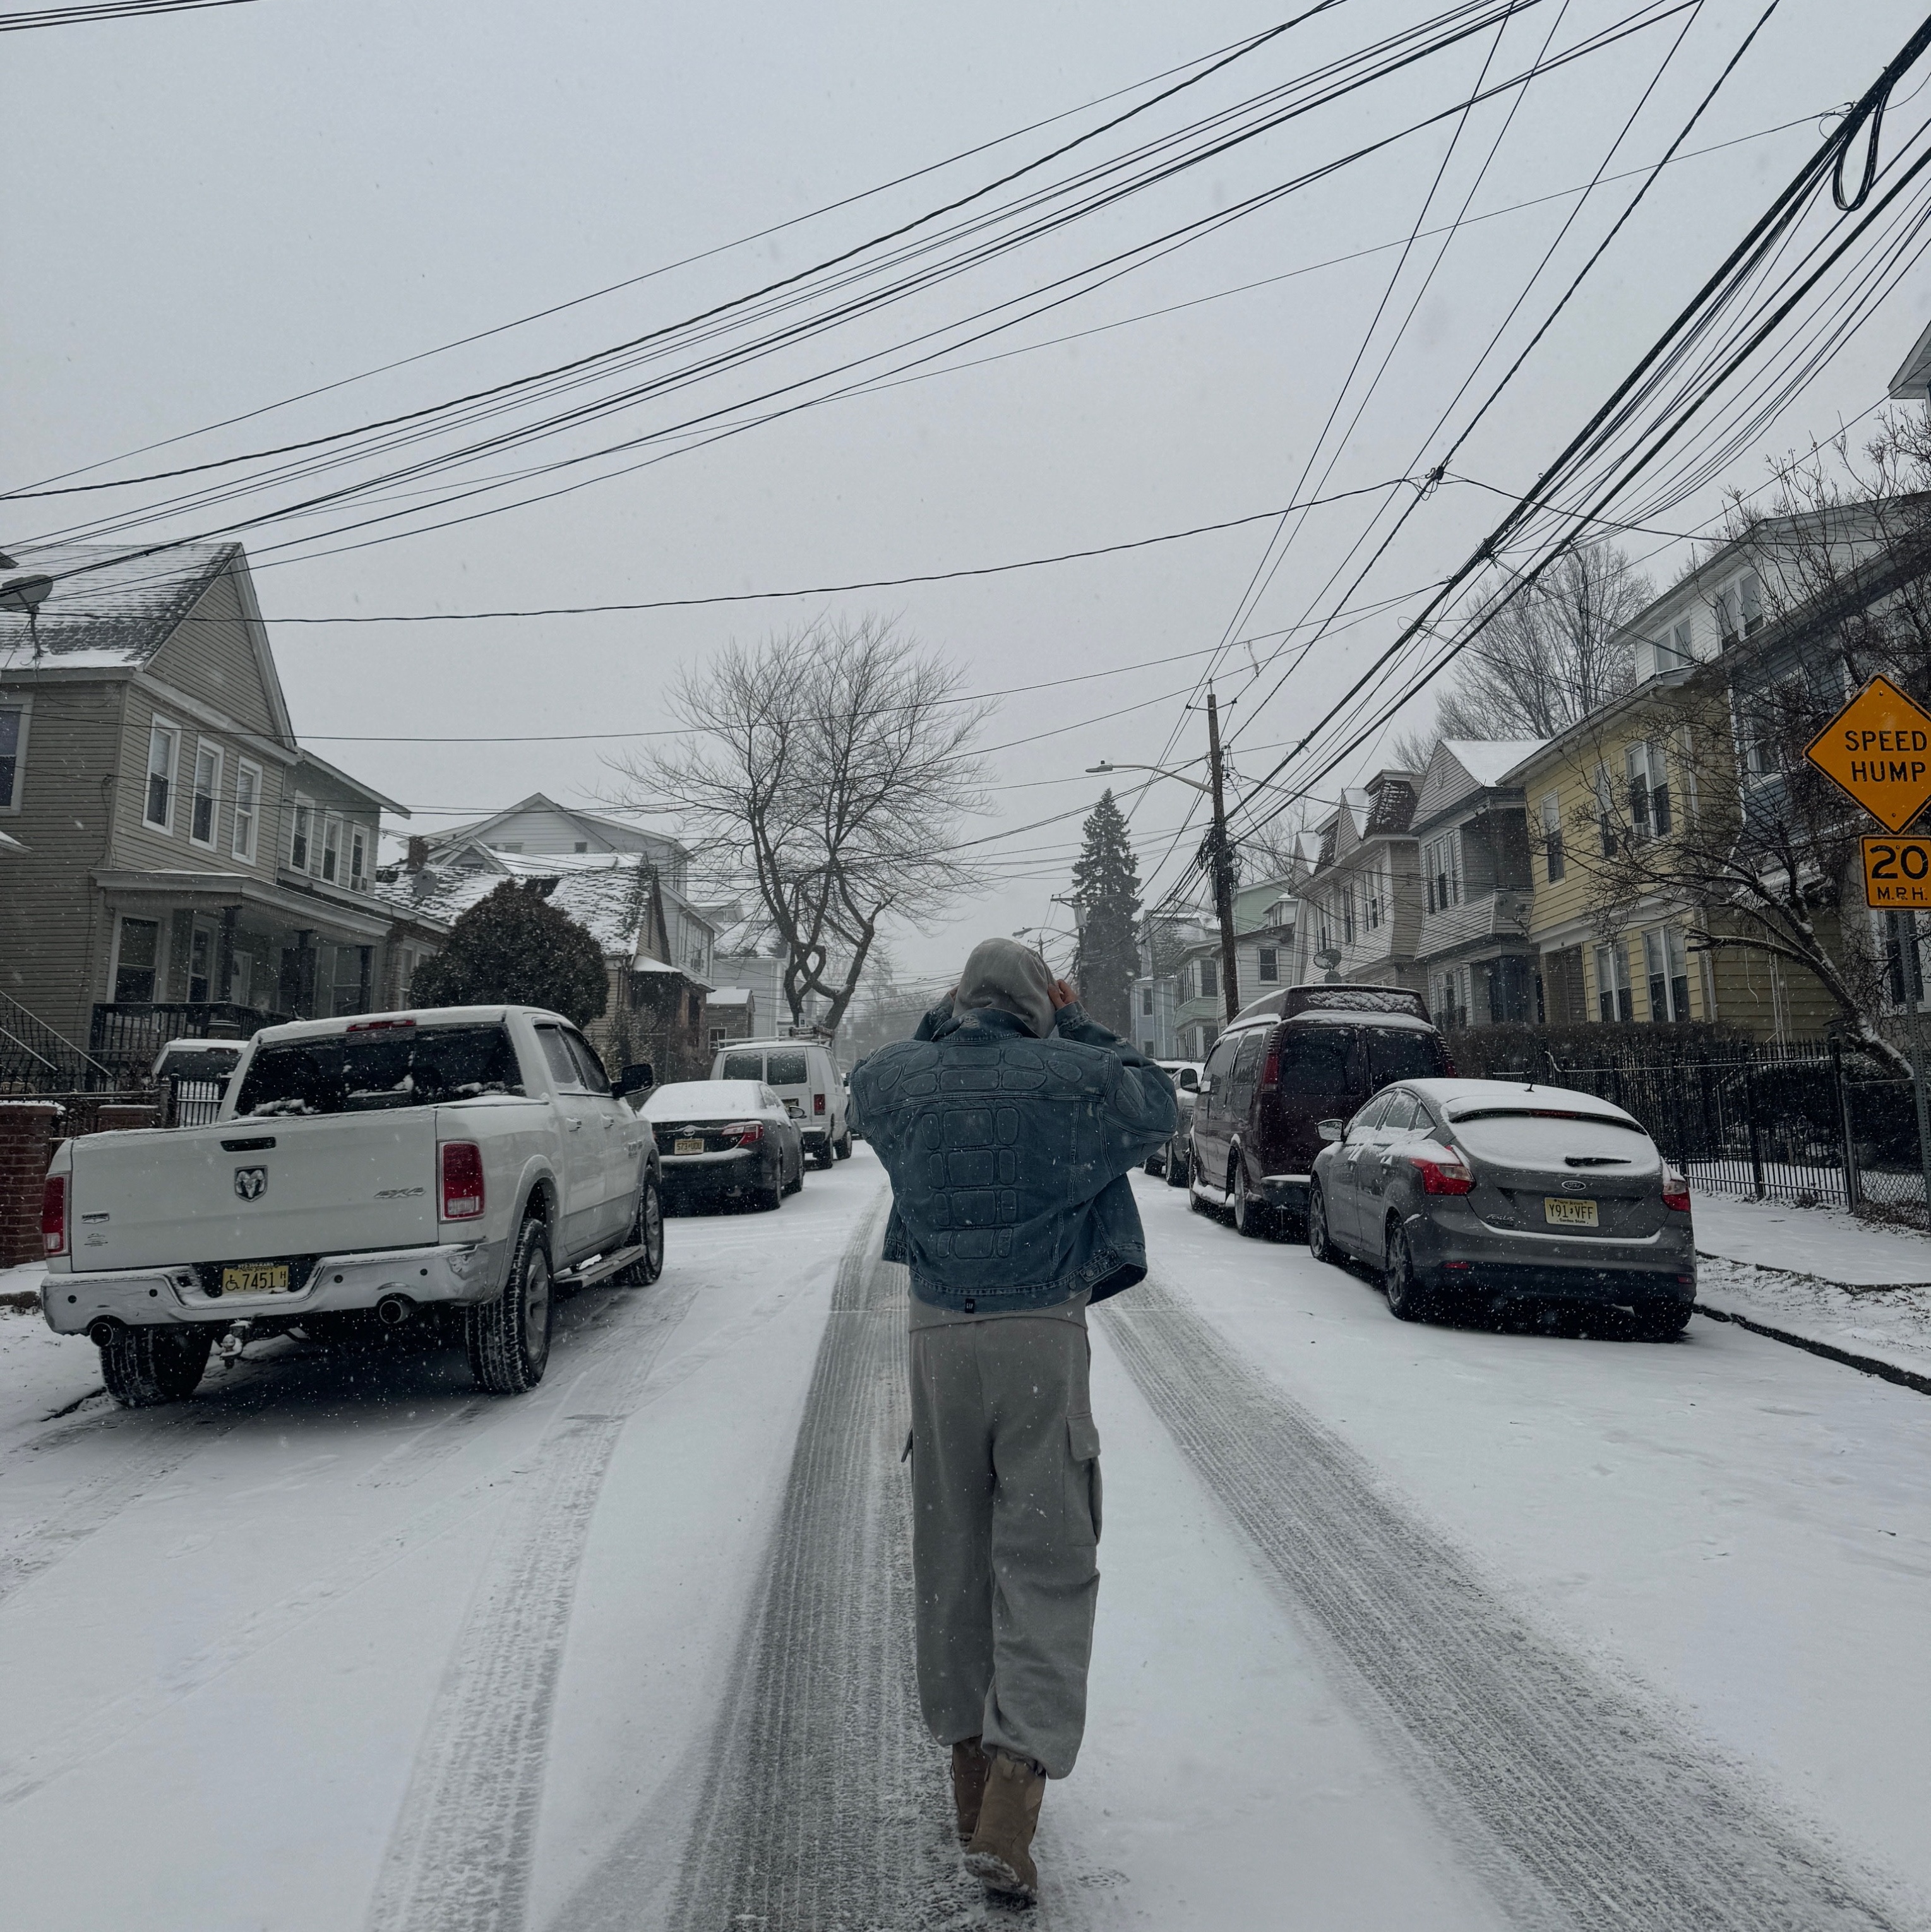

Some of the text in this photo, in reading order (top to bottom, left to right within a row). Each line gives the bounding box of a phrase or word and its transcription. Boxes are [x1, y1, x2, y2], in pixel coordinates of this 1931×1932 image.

[1845, 730, 1927, 751] SPEED
[1851, 761, 1926, 782] HUMP
[1870, 845, 1928, 880] 20
[242, 1272, 275, 1291] 7451
